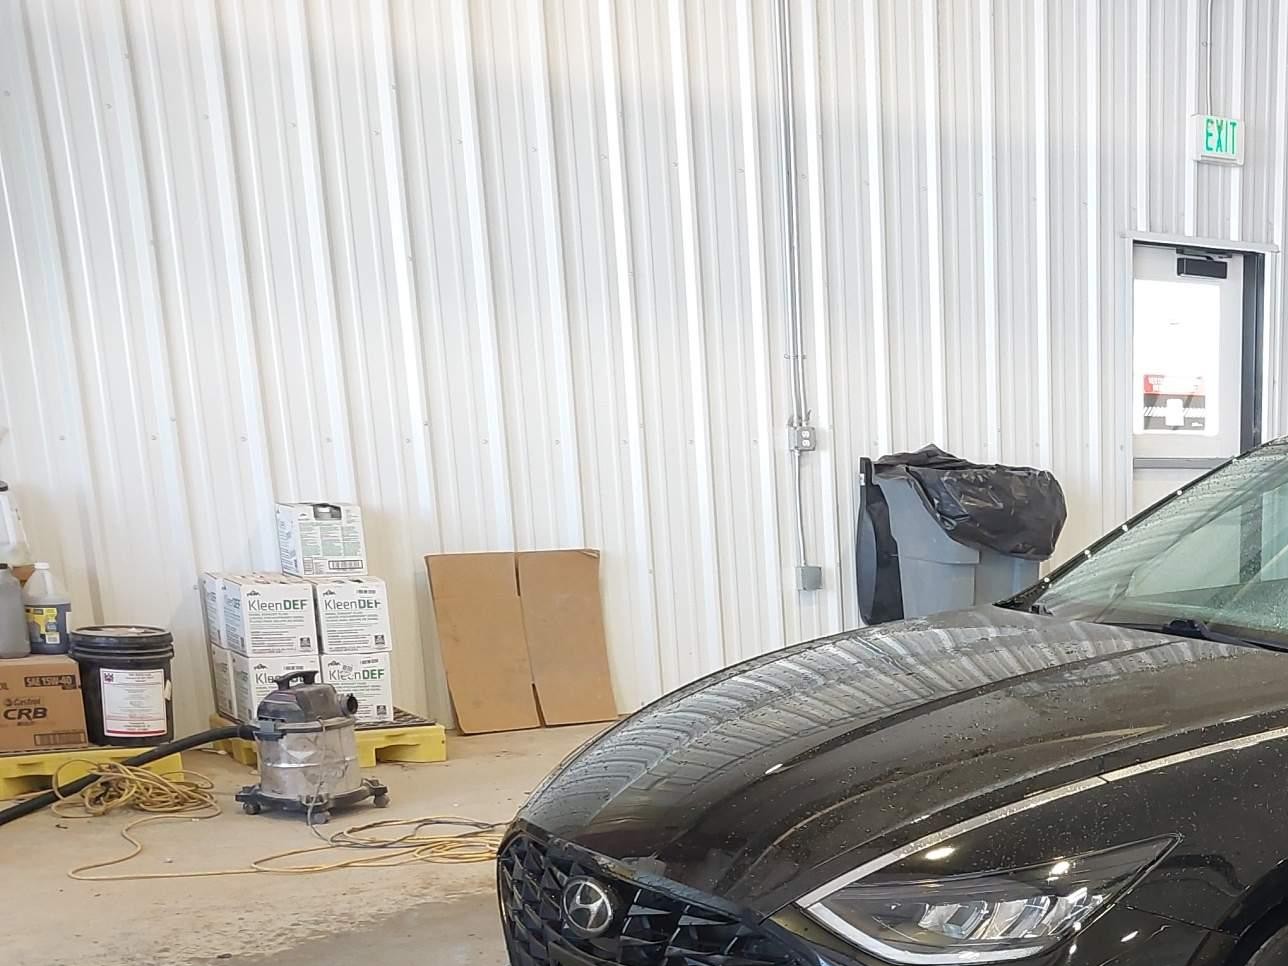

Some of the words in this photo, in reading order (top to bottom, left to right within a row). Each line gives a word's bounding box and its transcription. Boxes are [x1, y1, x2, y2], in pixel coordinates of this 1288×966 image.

[1205, 118, 1237, 155] EXIT
[248, 599, 309, 611] KleenDEF
[325, 599, 382, 611] KleenDEF
[3, 707, 48, 720] CRB
